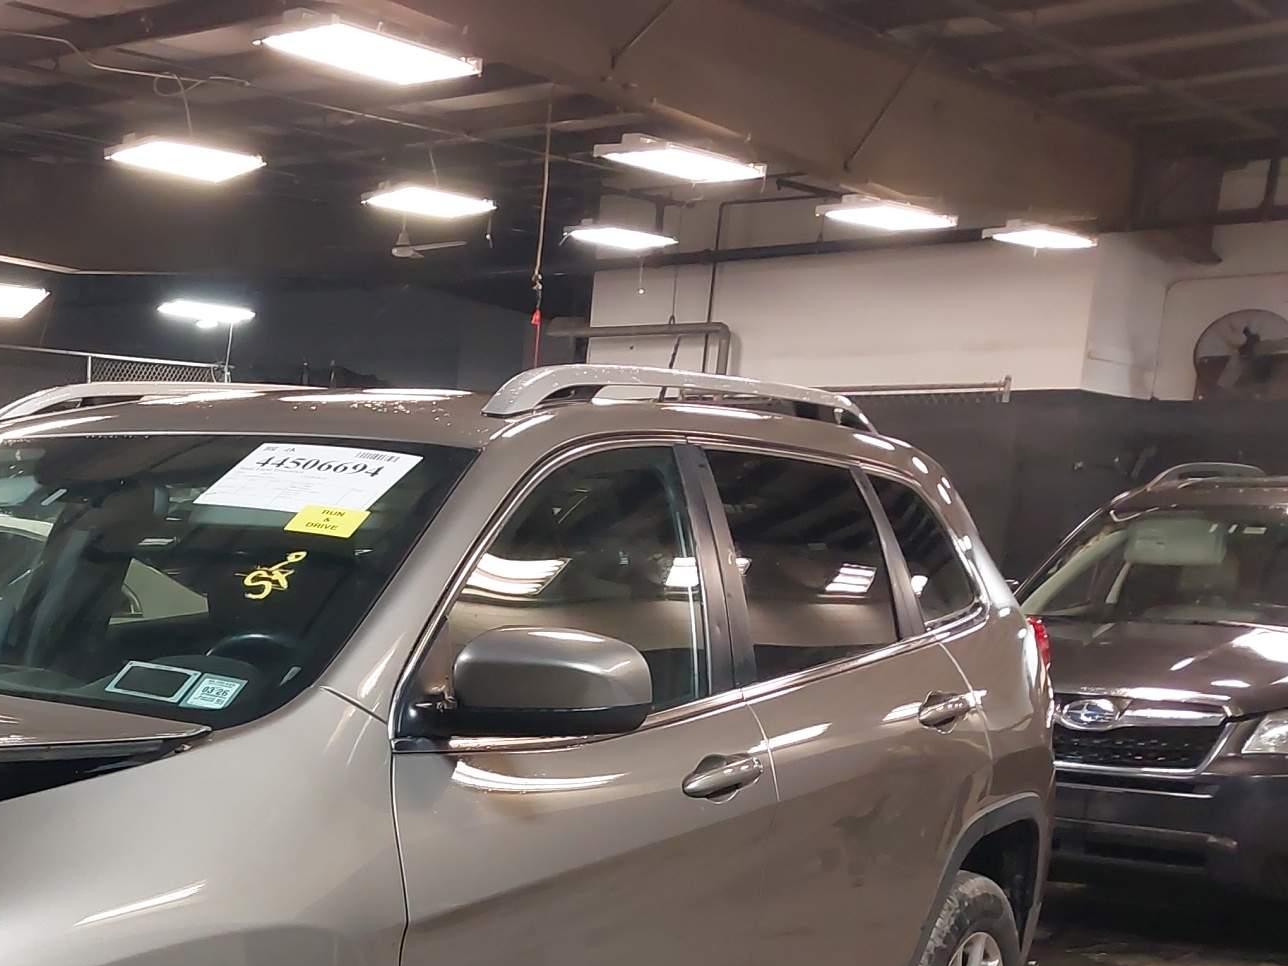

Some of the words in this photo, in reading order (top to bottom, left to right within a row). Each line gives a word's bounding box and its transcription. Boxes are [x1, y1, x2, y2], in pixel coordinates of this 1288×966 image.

[256, 456, 384, 477] 44506694
[322, 509, 345, 517] RUN
[305, 522, 338, 531] DRIVE
